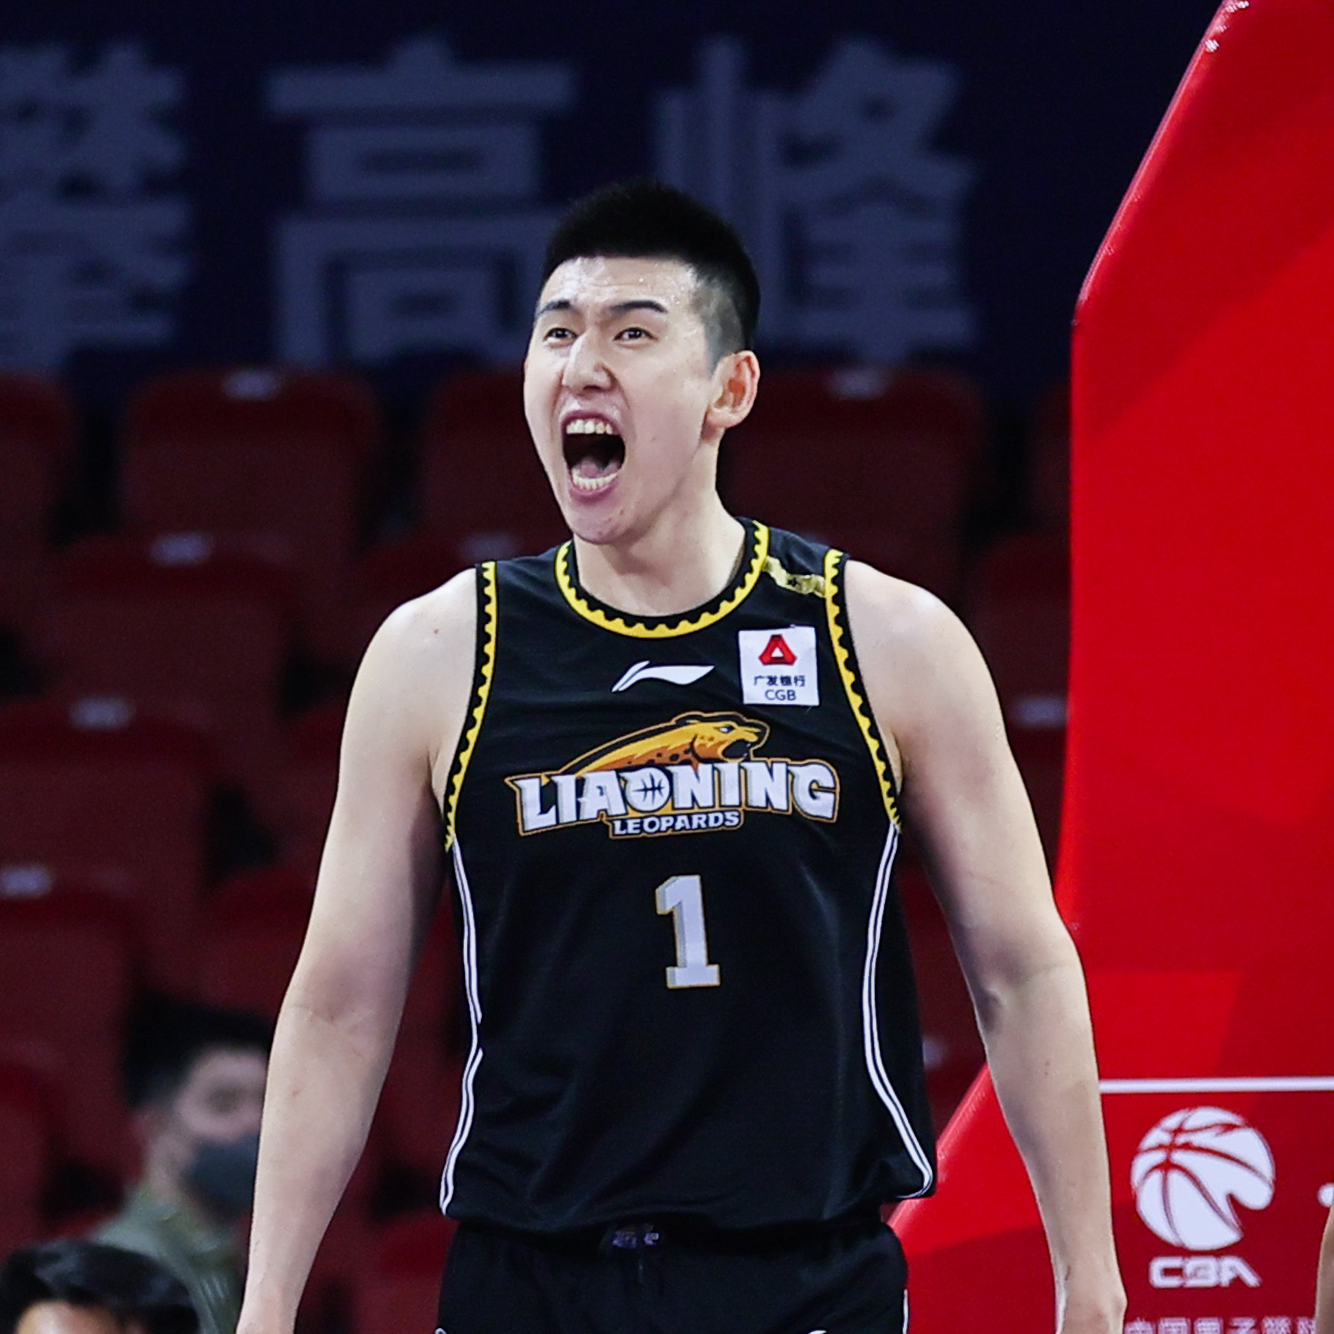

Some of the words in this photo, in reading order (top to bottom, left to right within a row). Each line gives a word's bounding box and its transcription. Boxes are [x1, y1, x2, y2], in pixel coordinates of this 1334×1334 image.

[765, 689, 797, 701] CGB
[511, 761, 838, 834] LIAONING
[613, 810, 742, 836] LEOPARDS
[655, 875, 721, 989] 1
[1149, 1255, 1262, 1288] CBA
